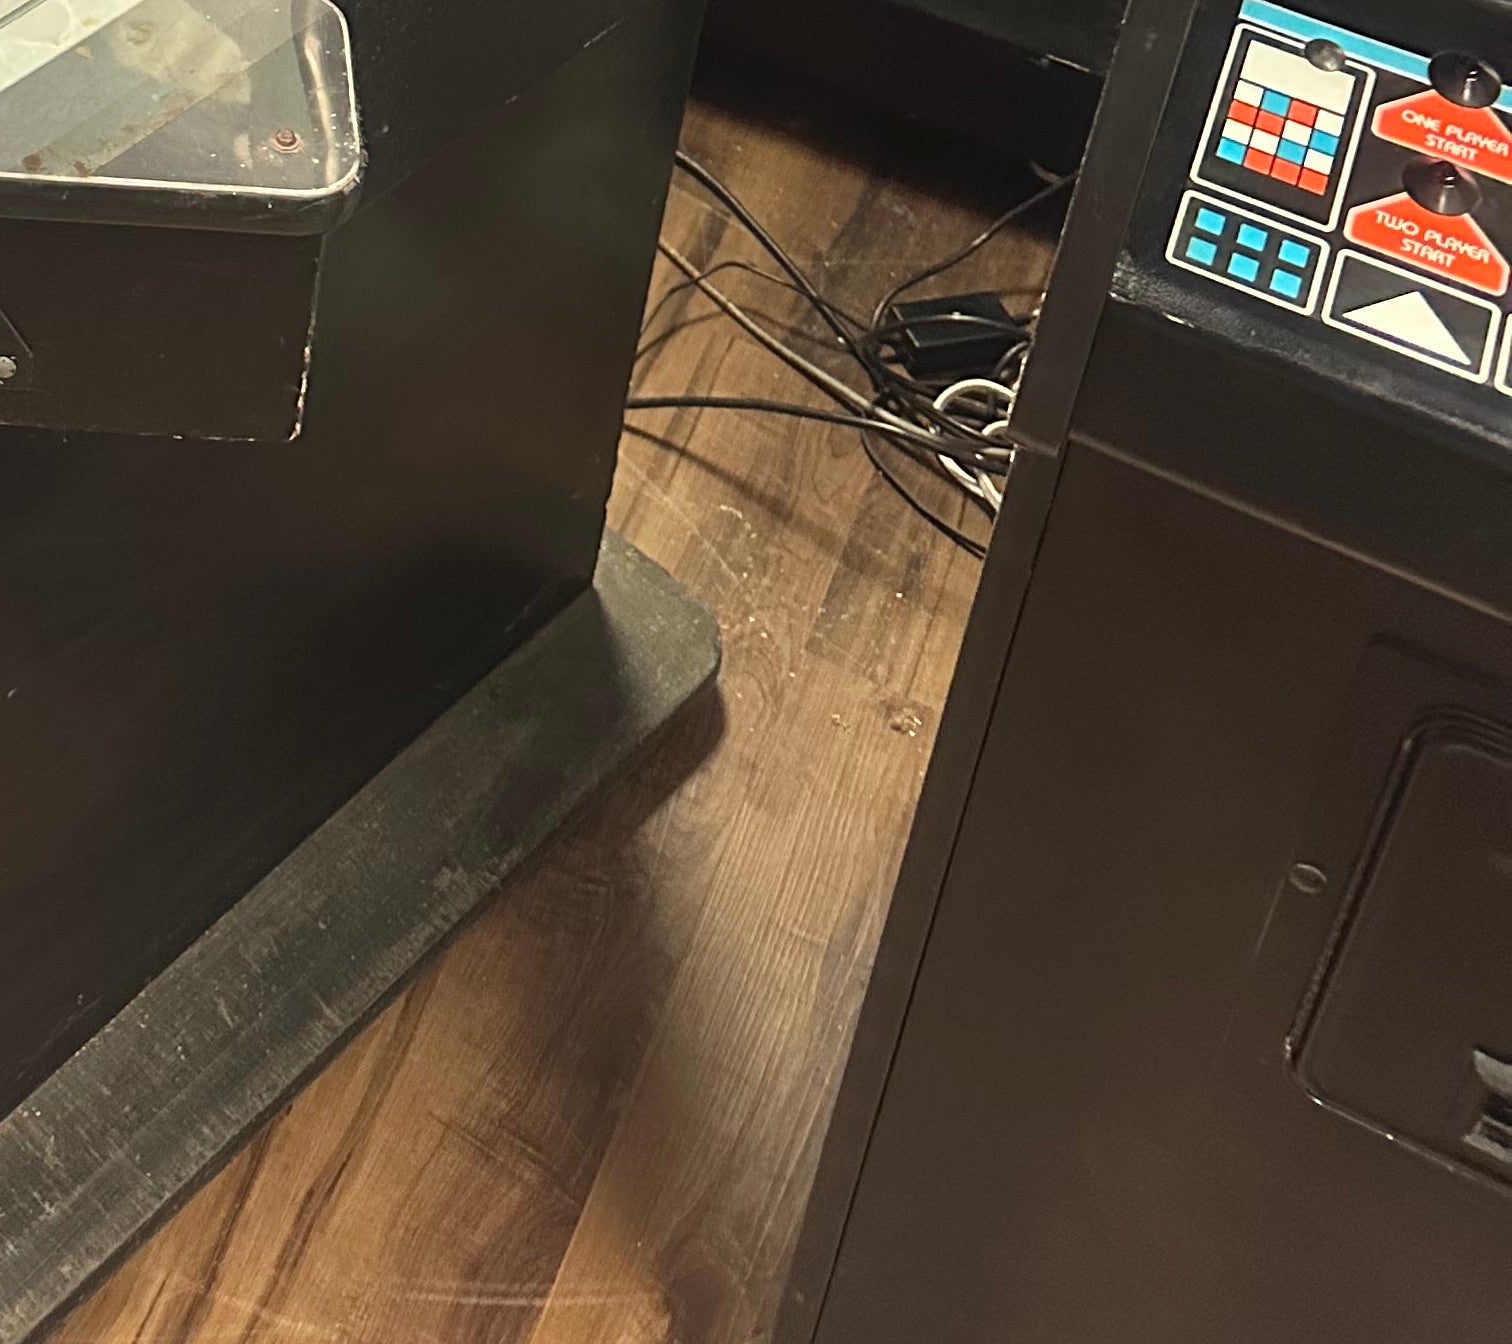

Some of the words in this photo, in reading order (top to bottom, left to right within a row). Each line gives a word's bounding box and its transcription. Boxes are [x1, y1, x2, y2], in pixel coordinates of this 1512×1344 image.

[1400, 108, 1442, 133] ONE
[1444, 123, 1510, 158] PLAYER
[1423, 133, 1479, 162] START
[1374, 209, 1420, 237] TWO
[1423, 228, 1492, 265] PLAYER
[1400, 237, 1457, 269] START
